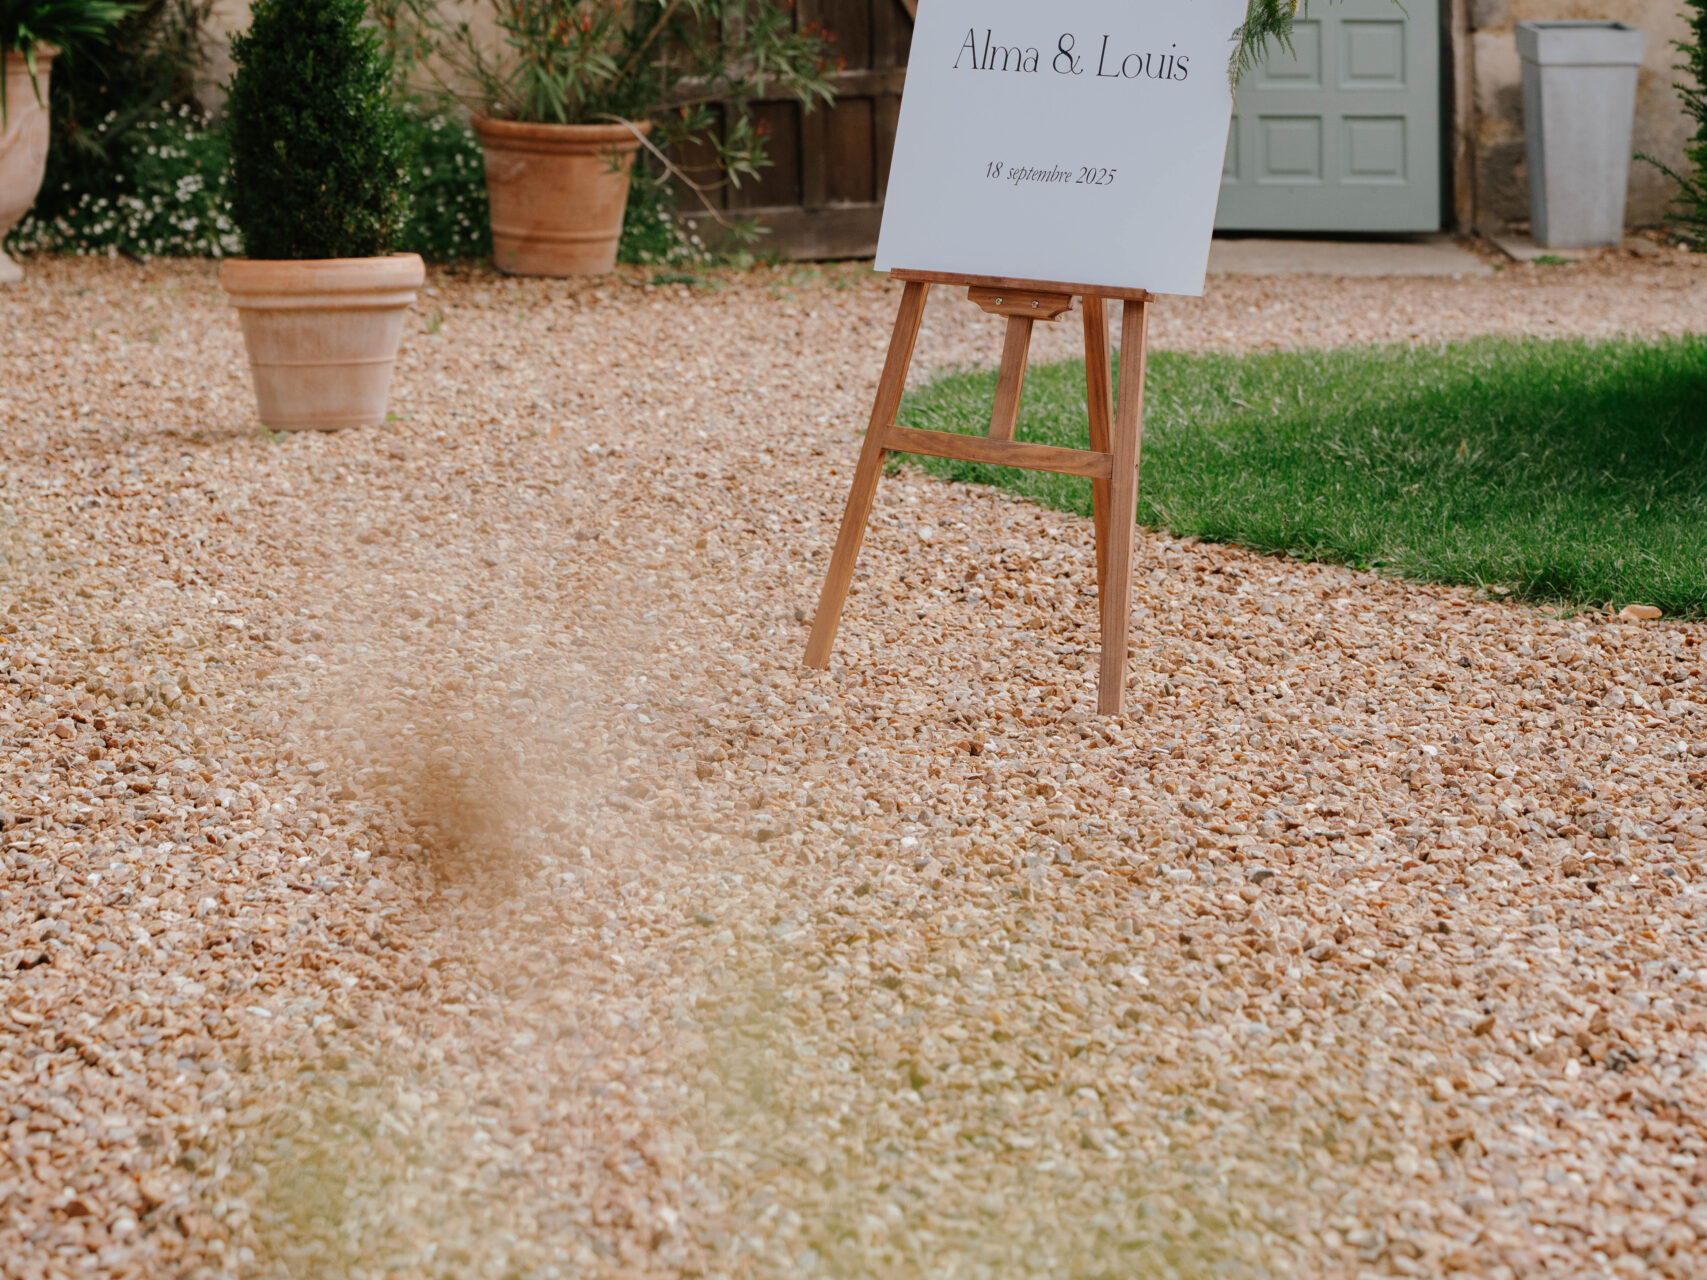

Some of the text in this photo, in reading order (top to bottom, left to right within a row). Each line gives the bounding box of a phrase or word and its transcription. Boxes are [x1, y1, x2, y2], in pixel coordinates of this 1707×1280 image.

[952, 27, 1190, 81] Alma & Louis
[985, 161, 1118, 186] 18 septembre 2025
